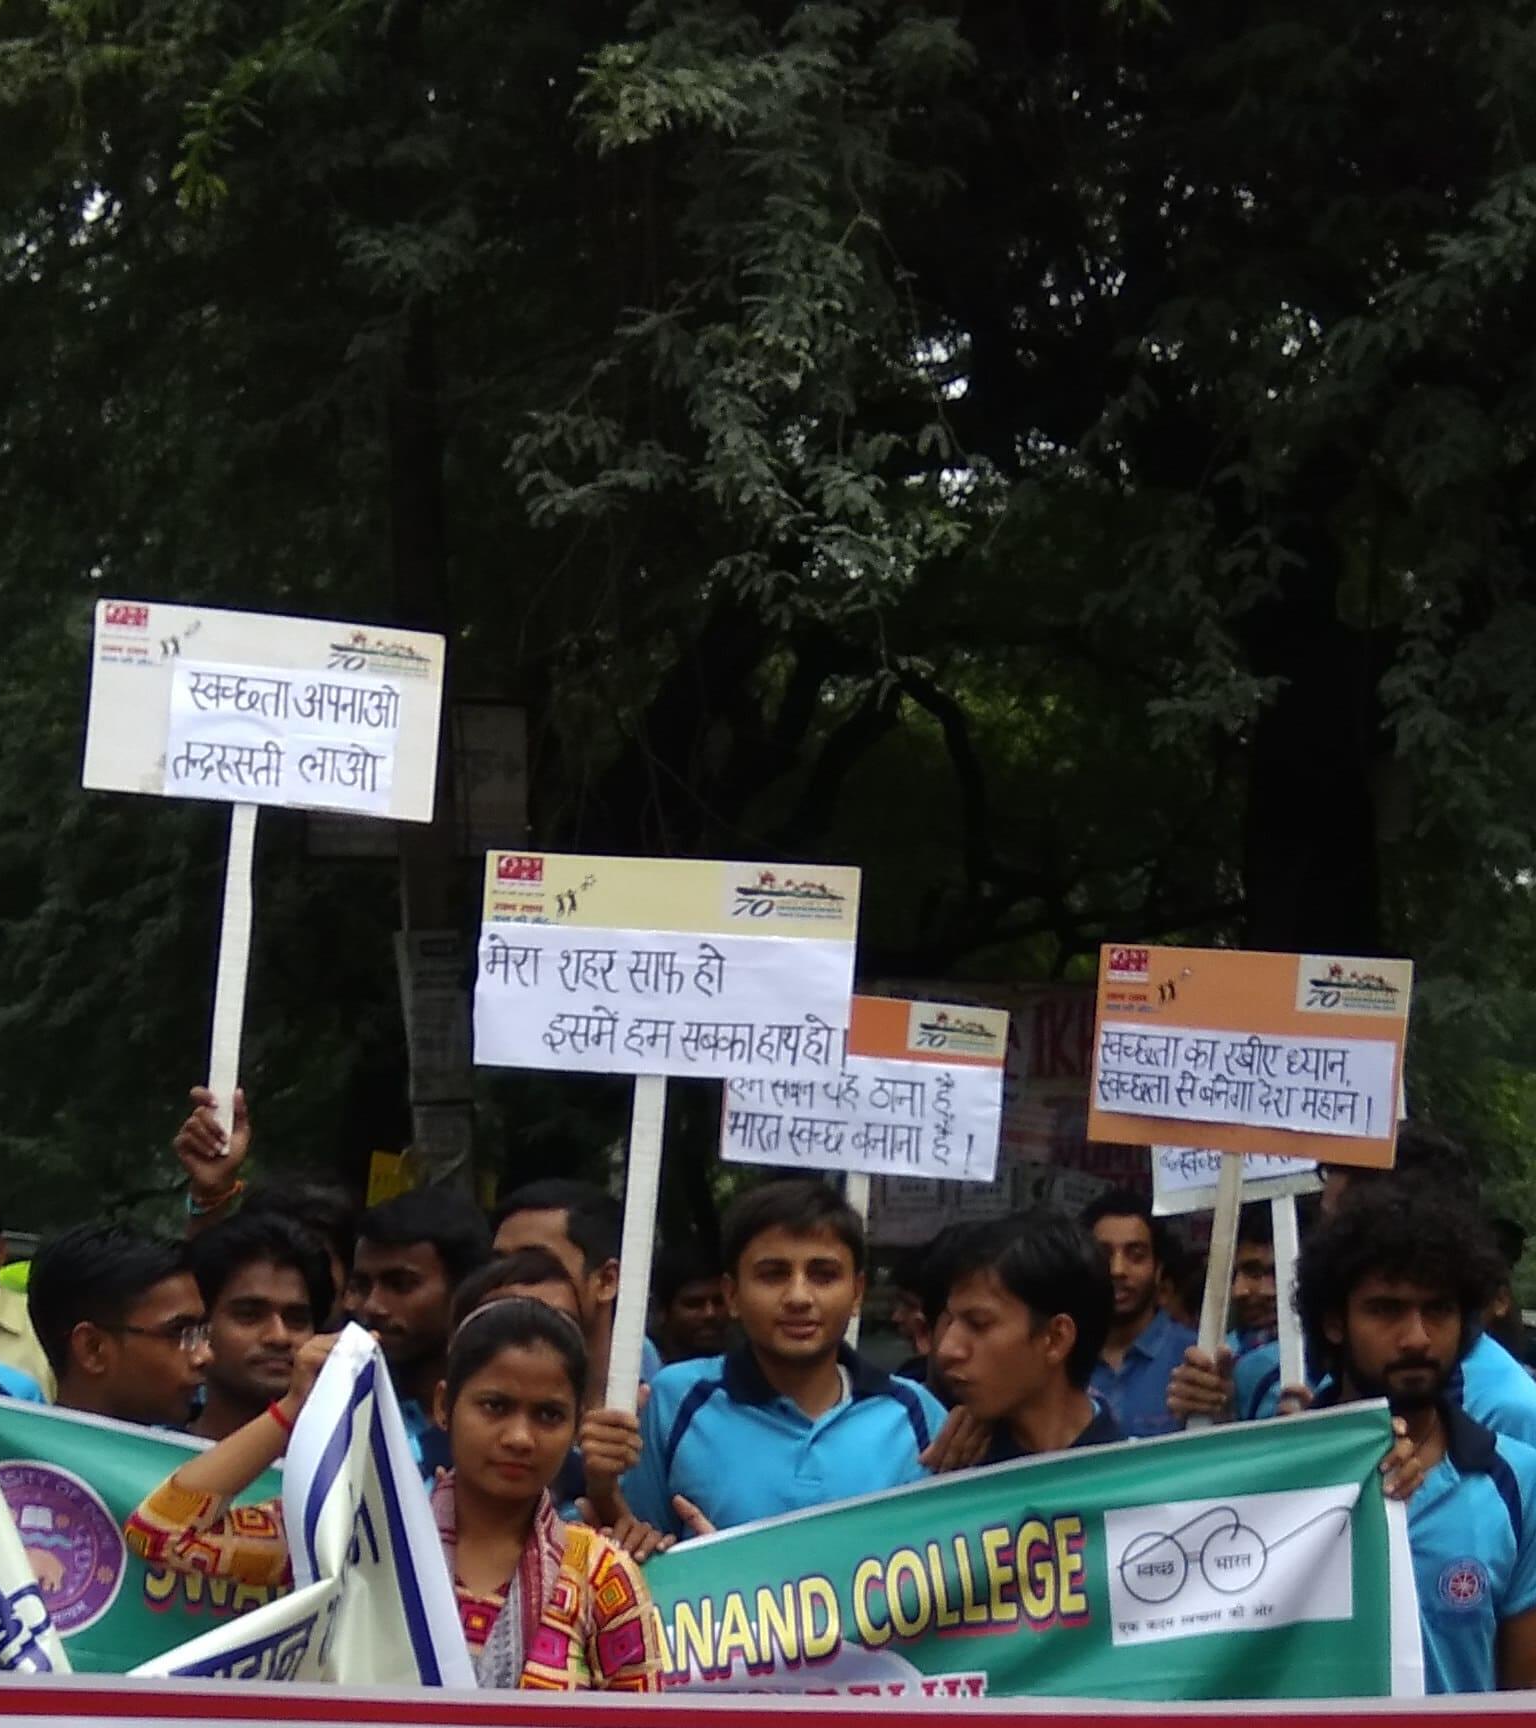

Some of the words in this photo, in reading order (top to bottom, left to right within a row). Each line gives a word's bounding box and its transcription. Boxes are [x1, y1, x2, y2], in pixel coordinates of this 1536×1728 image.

[189, 672, 292, 719] स्वच्छता
[295, 683, 401, 728] अपनाओ
[299, 743, 387, 792] लाओ
[733, 898, 774, 916] 70
[485, 934, 542, 986] मेरा
[559, 948, 619, 993] शहर
[626, 950, 684, 995] साफ
[693, 942, 726, 997] हो
[542, 1005, 619, 1054] इसमें
[624, 1018, 675, 1058] हम
[1101, 1031, 1183, 1068] स्वच्छता
[1185, 1039, 1220, 1070] का
[1099, 1070, 1176, 1108] स्वच्छता
[1176, 1071, 1199, 1107] से
[1200, 1074, 1256, 1112] बनेगा
[1301, 1088, 1359, 1124] महान
[728, 1110, 784, 1151] भारत
[788, 1116, 849, 1157] स्वच्छ
[852, 1122, 923, 1165] बनाना
[852, 1514, 1091, 1648] COLLEGE
[1214, 1553, 1251, 1571] भारत
